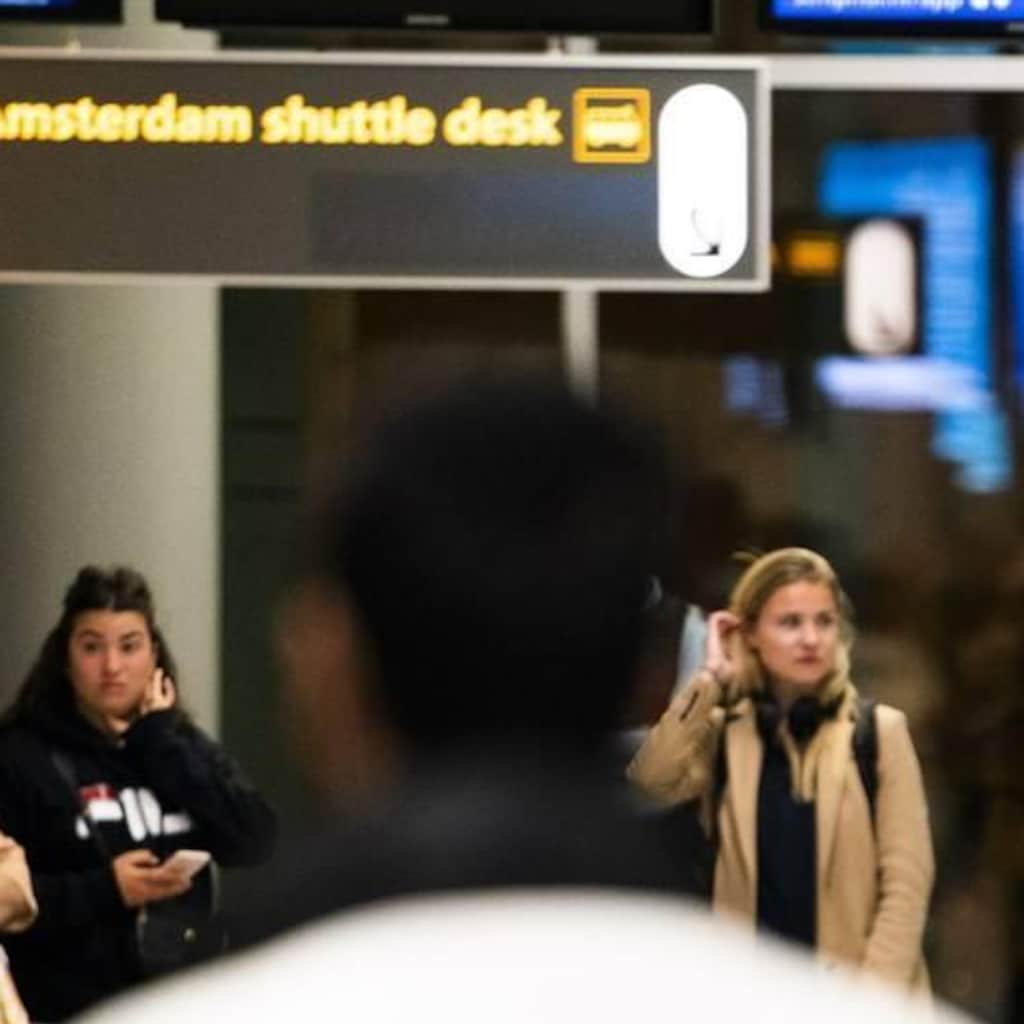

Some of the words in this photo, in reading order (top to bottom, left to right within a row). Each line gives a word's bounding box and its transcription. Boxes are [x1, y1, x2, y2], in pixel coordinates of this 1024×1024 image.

[0, 91, 253, 143] msterdam
[260, 93, 437, 146] shuttle
[442, 95, 564, 147] desk
